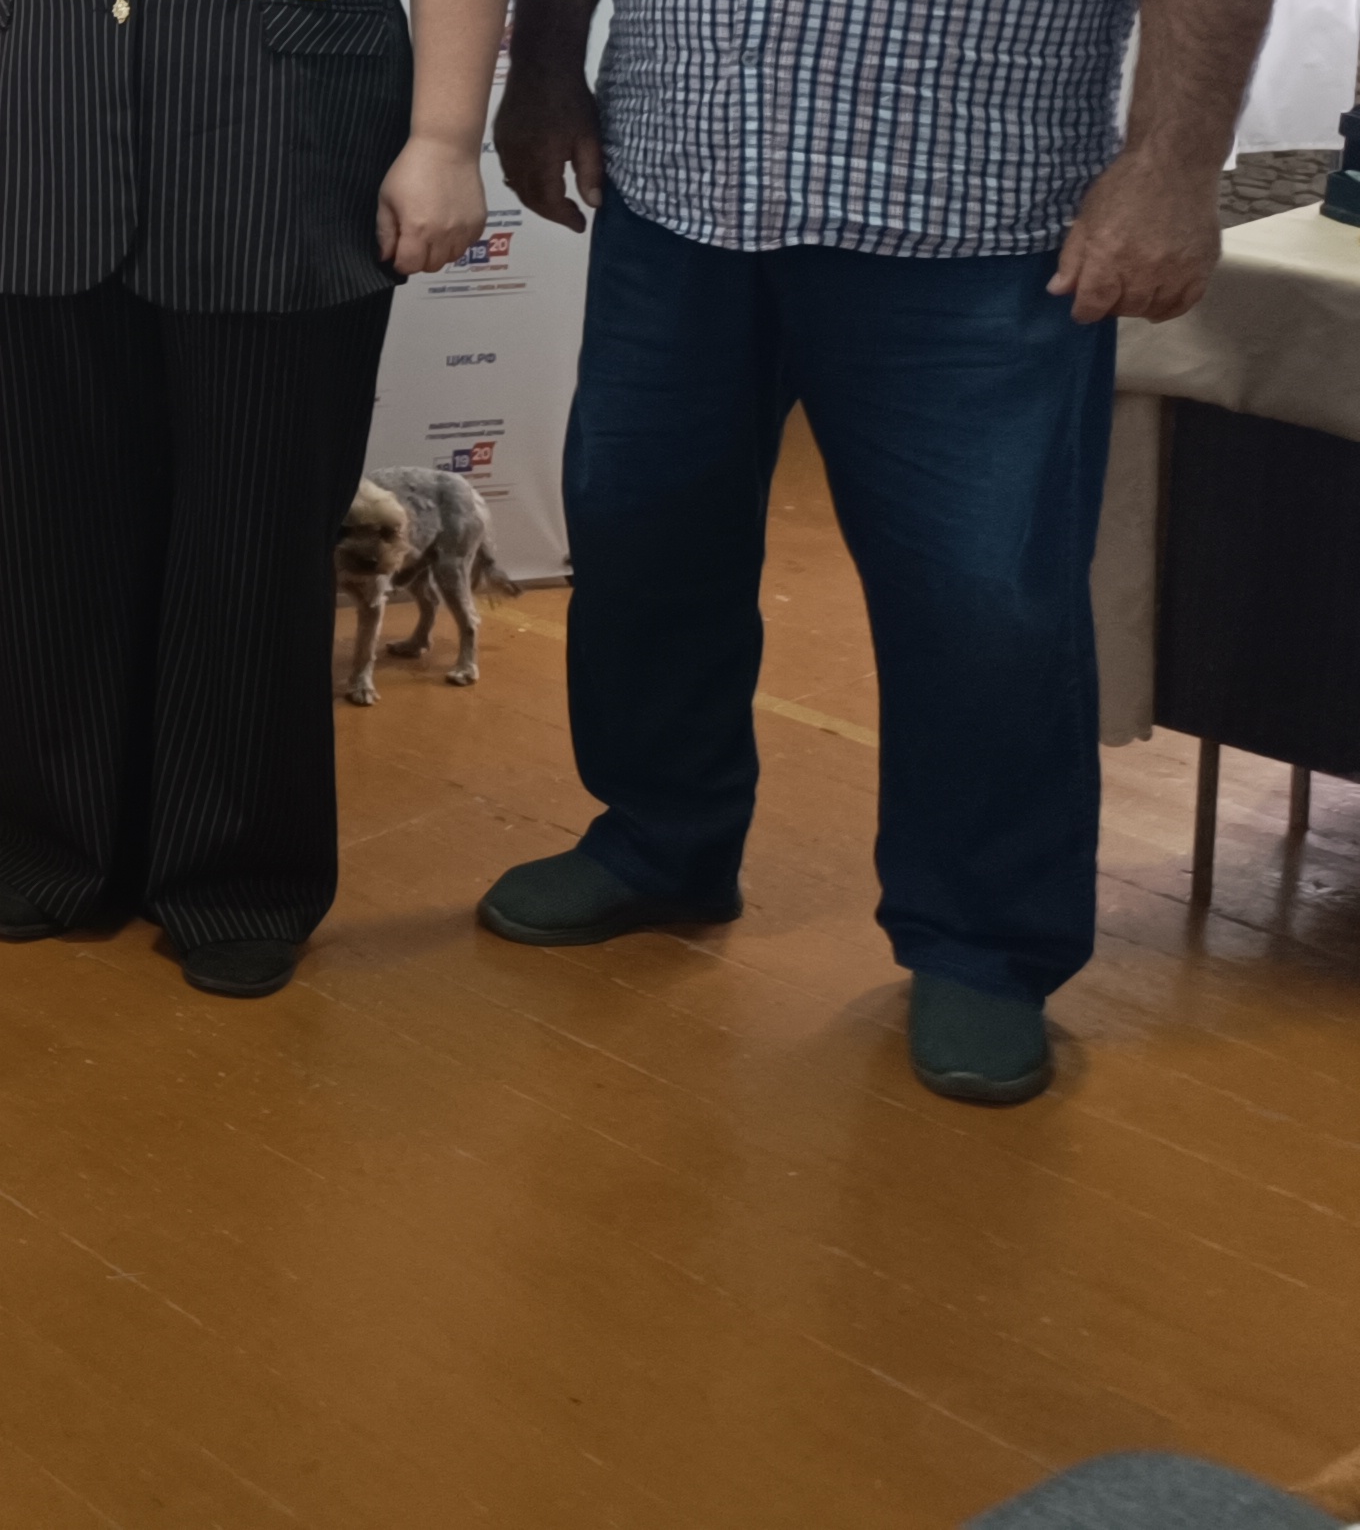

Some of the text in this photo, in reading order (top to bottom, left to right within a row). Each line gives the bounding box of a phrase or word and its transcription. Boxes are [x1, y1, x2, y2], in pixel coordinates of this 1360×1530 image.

[489, 238, 508, 252] 20
[472, 246, 486, 259] 19
[446, 353, 497, 366] ЦИК.РФ
[472, 448, 491, 460] 20
[454, 455, 470, 468] 19
